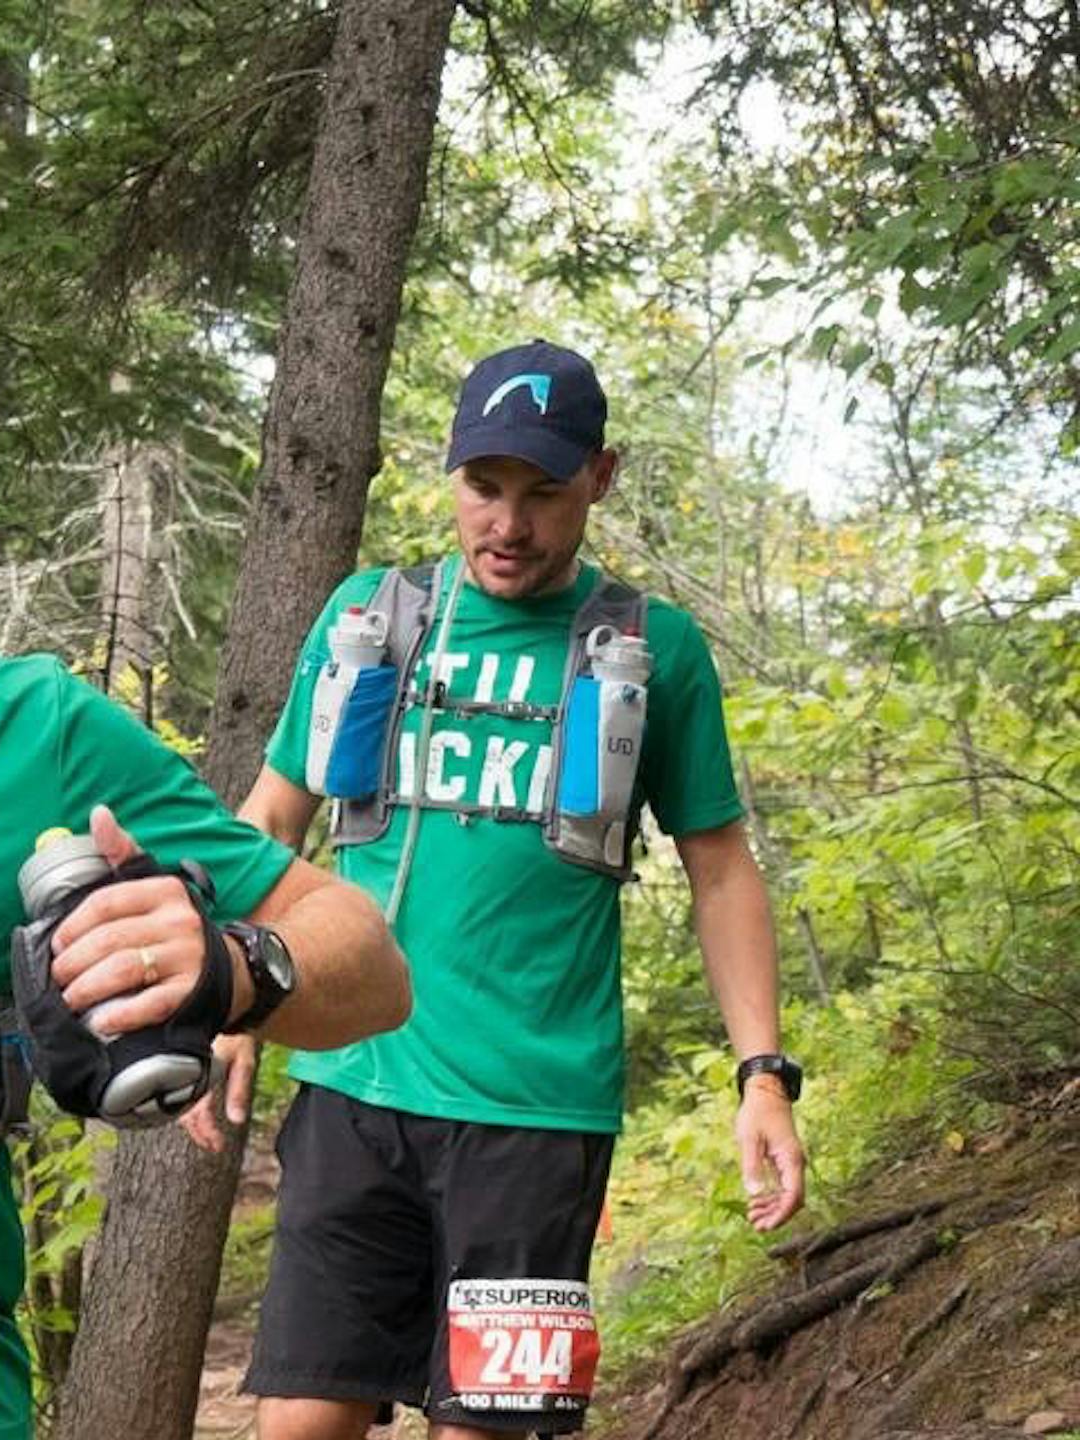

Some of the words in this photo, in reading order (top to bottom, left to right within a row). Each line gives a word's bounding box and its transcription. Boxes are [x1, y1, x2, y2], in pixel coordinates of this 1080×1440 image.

[479, 1329, 573, 1386] 244
[458, 1394, 491, 1408] 100
[494, 1394, 543, 1409] MILE
